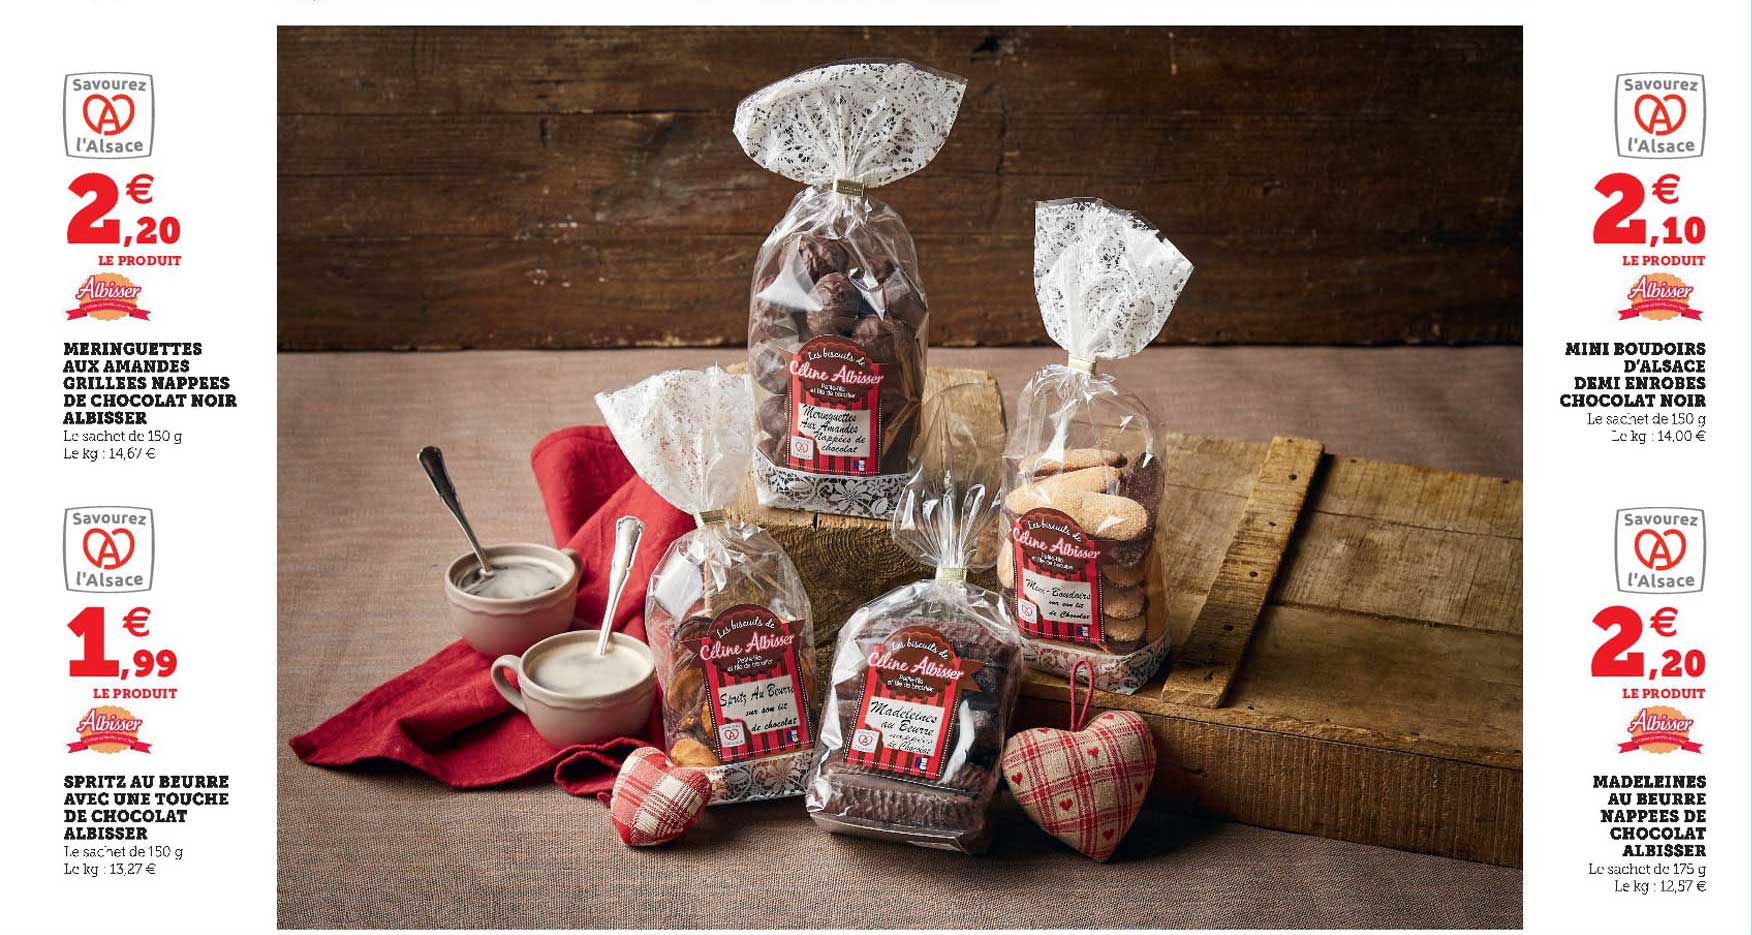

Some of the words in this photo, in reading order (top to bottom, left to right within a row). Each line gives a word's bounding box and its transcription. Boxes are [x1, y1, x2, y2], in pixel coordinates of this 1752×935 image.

[73, 79, 146, 91] Savourez
[1625, 79, 1697, 91] Savourez
[77, 138, 142, 152] l'Alsace
[1629, 138, 1694, 152] l'Alsace
[98, 256, 114, 266] LE
[118, 256, 182, 266] PRODUIT
[1623, 256, 1639, 266] LE
[1642, 256, 1705, 266] PRODUIT
[75, 275, 142, 299] Albisser
[1627, 275, 1694, 299] Albisser
[64, 342, 202, 355] MERINGUETTES
[1565, 343, 1609, 355] MINI
[1614, 342, 1706, 355] BOUDOIRS
[808, 351, 822, 360] Les
[823, 348, 853, 362] biscuits
[856, 356, 865, 367] de
[63, 360, 99, 373] AUX
[103, 359, 189, 373] AMANDES
[790, 360, 829, 381] Céline
[831, 365, 884, 384] Albisser
[1624, 359, 1706, 373] D'ALSACE
[63, 377, 147, 389] GRILLEES
[152, 377, 230, 389] NAPPEES
[1575, 377, 1620, 389] DEMI
[1625, 377, 1706, 390] ENROBES
[64, 394, 86, 407] DE
[91, 394, 187, 407] CHOCOLAT
[191, 394, 237, 407] NOIR
[1560, 394, 1656, 407] CHOCOLAT
[1660, 394, 1706, 407] NOIR
[63, 411, 147, 424] ALBISSER
[802, 404, 856, 422] Meringuettes
[1588, 413, 1602, 424] Le
[1607, 413, 1648, 425] sachet
[1652, 413, 1668, 424] de
[1672, 413, 1694, 424] 150
[1698, 416, 1706, 428] g
[820, 422, 858, 434] Amandes
[64, 430, 79, 441] Le
[83, 430, 125, 441] sachet
[129, 430, 144, 441] de
[148, 430, 170, 441] 150
[174, 433, 182, 444] g
[855, 435, 865, 443] de
[1631, 430, 1646, 444] kg
[1658, 430, 1692, 442] 14,00
[1696, 430, 1706, 441] €
[64, 448, 79, 459] Le
[83, 448, 97, 462] kg
[110, 447, 142, 460] 14,67
[146, 448, 156, 459] €
[73, 513, 146, 525] Savourez
[1625, 514, 1697, 526] Savourez
[1028, 521, 1040, 530] Les
[1041, 519, 1070, 536] biscuits
[1072, 532, 1082, 542] de
[1012, 527, 1048, 550] Céline
[1049, 538, 1100, 558] Albisser
[77, 572, 142, 586] l'Alsace
[1629, 573, 1694, 587] l'Alsace
[717, 626, 731, 639] Les
[731, 617, 763, 629] biscuits
[766, 618, 775, 629] de
[700, 641, 742, 660] Céline
[745, 632, 795, 653] Albisser
[907, 637, 937, 653] biscuits
[939, 649, 948, 660] de
[868, 652, 909, 671] Céline
[910, 656, 964, 680] Albisser
[93, 689, 109, 698] LE
[113, 689, 177, 699] PRODUIT
[1623, 689, 1639, 698] LE
[1642, 689, 1705, 698] PRODUIT
[871, 701, 937, 723] Madeleines
[76, 709, 143, 733] Albisser
[751, 724, 761, 732] de
[764, 717, 797, 729] chocolat
[1627, 708, 1694, 733] Albisser
[899, 720, 934, 736] Beurre
[64, 776, 126, 788] SPRITZ
[130, 776, 155, 788] AU
[159, 776, 229, 788] BEURRE
[1593, 776, 1706, 788] MADELEINES
[64, 792, 109, 806] AVEC
[113, 793, 150, 806] UNE
[155, 792, 229, 806] TOUCHE
[1608, 793, 1632, 806] AU
[1637, 793, 1706, 806] BEURRE
[64, 810, 87, 822] DE
[91, 810, 187, 822] CHOCOLAT
[1600, 810, 1679, 822] NAPPEES
[1684, 810, 1706, 822] DE
[64, 827, 148, 840] ALBISSER
[1610, 827, 1706, 840] CHOCOLAT
[64, 846, 79, 857] Le
[83, 846, 125, 857] sachet
[129, 846, 145, 857] de
[149, 846, 171, 857] 150
[175, 849, 183, 860] g
[1622, 844, 1706, 857] ALBISSER
[64, 863, 79, 874] Le
[83, 863, 98, 877] kg
[110, 863, 142, 876] 13,27
[146, 863, 156, 874] €
[1589, 863, 1604, 874] Le
[1608, 863, 1650, 874] sachet
[1654, 863, 1669, 874] de
[1674, 863, 1694, 874] 175
[1699, 866, 1706, 877] g
[1615, 880, 1630, 892] Le
[1634, 880, 1649, 895] kg
[1661, 880, 1693, 894] 12,57
[1697, 881, 1706, 892] €
